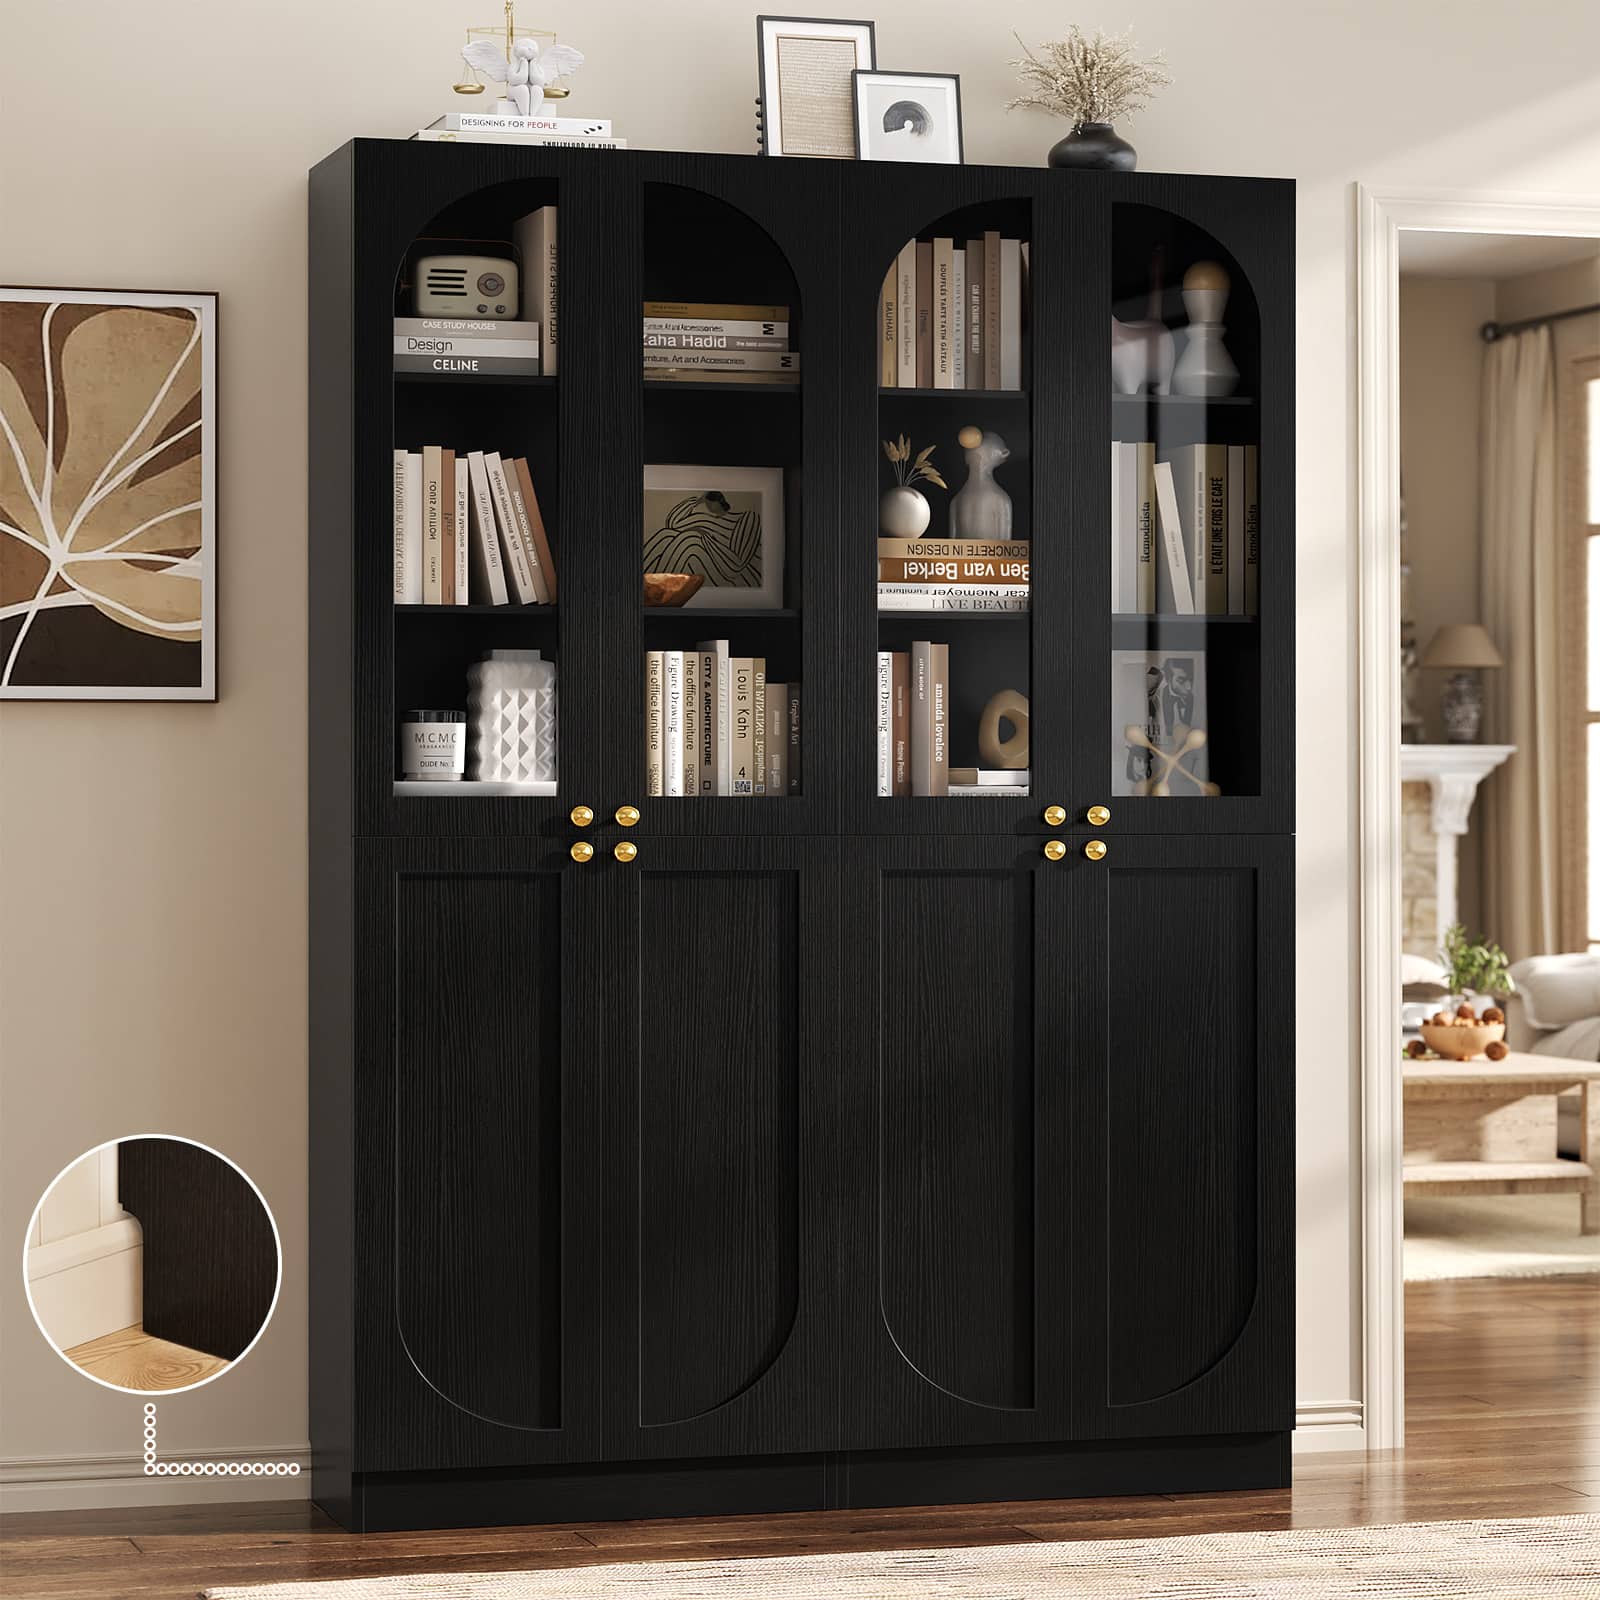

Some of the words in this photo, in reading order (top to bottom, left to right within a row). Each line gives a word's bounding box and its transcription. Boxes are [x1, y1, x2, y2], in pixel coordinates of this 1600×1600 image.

[461, 118, 505, 128] DESIGNING
[507, 120, 524, 128] FOR
[527, 121, 558, 130] PEOPLE
[423, 321, 442, 329] CASE
[443, 321, 465, 330] STUDY
[467, 322, 497, 331] HOUSES
[763, 323, 775, 335] M
[408, 337, 453, 354] Design
[682, 336, 727, 348] Hadid
[433, 359, 479, 372] CELINE
[781, 356, 792, 368] M
[1212, 498, 1223, 508] LE
[1212, 509, 1223, 526] FOIS
[1140, 502, 1150, 563] Remodelista
[1212, 528, 1223, 543] UNE
[907, 544, 950, 556] DESIGN
[952, 544, 963, 556] IN
[967, 545, 1028, 557] CONCRETE
[1210, 545, 1223, 565] ÉTAIT
[904, 561, 958, 580] Berkel
[964, 562, 995, 576] van
[1000, 563, 1029, 581] Ben
[1212, 567, 1223, 575] IL
[931, 587, 999, 597] Niemeyer
[932, 600, 968, 609] LIVE
[973, 600, 1028, 610] BEAUT
[650, 660, 659, 675] the
[668, 657, 680, 689] Figure
[686, 660, 696, 675] the
[704, 657, 712, 678] CITY
[879, 657, 890, 688] Figure
[737, 669, 750, 701] Louis
[935, 683, 945, 720] amanda
[668, 691, 680, 733] Drawing
[879, 691, 890, 732] Drawing
[650, 709, 661, 750] furniture
[686, 709, 696, 750] furniture
[704, 692, 712, 766] ARCHITECTURE
[737, 709, 750, 739] Kahn
[935, 723, 945, 762] lovelace
[739, 767, 746, 777] 4
